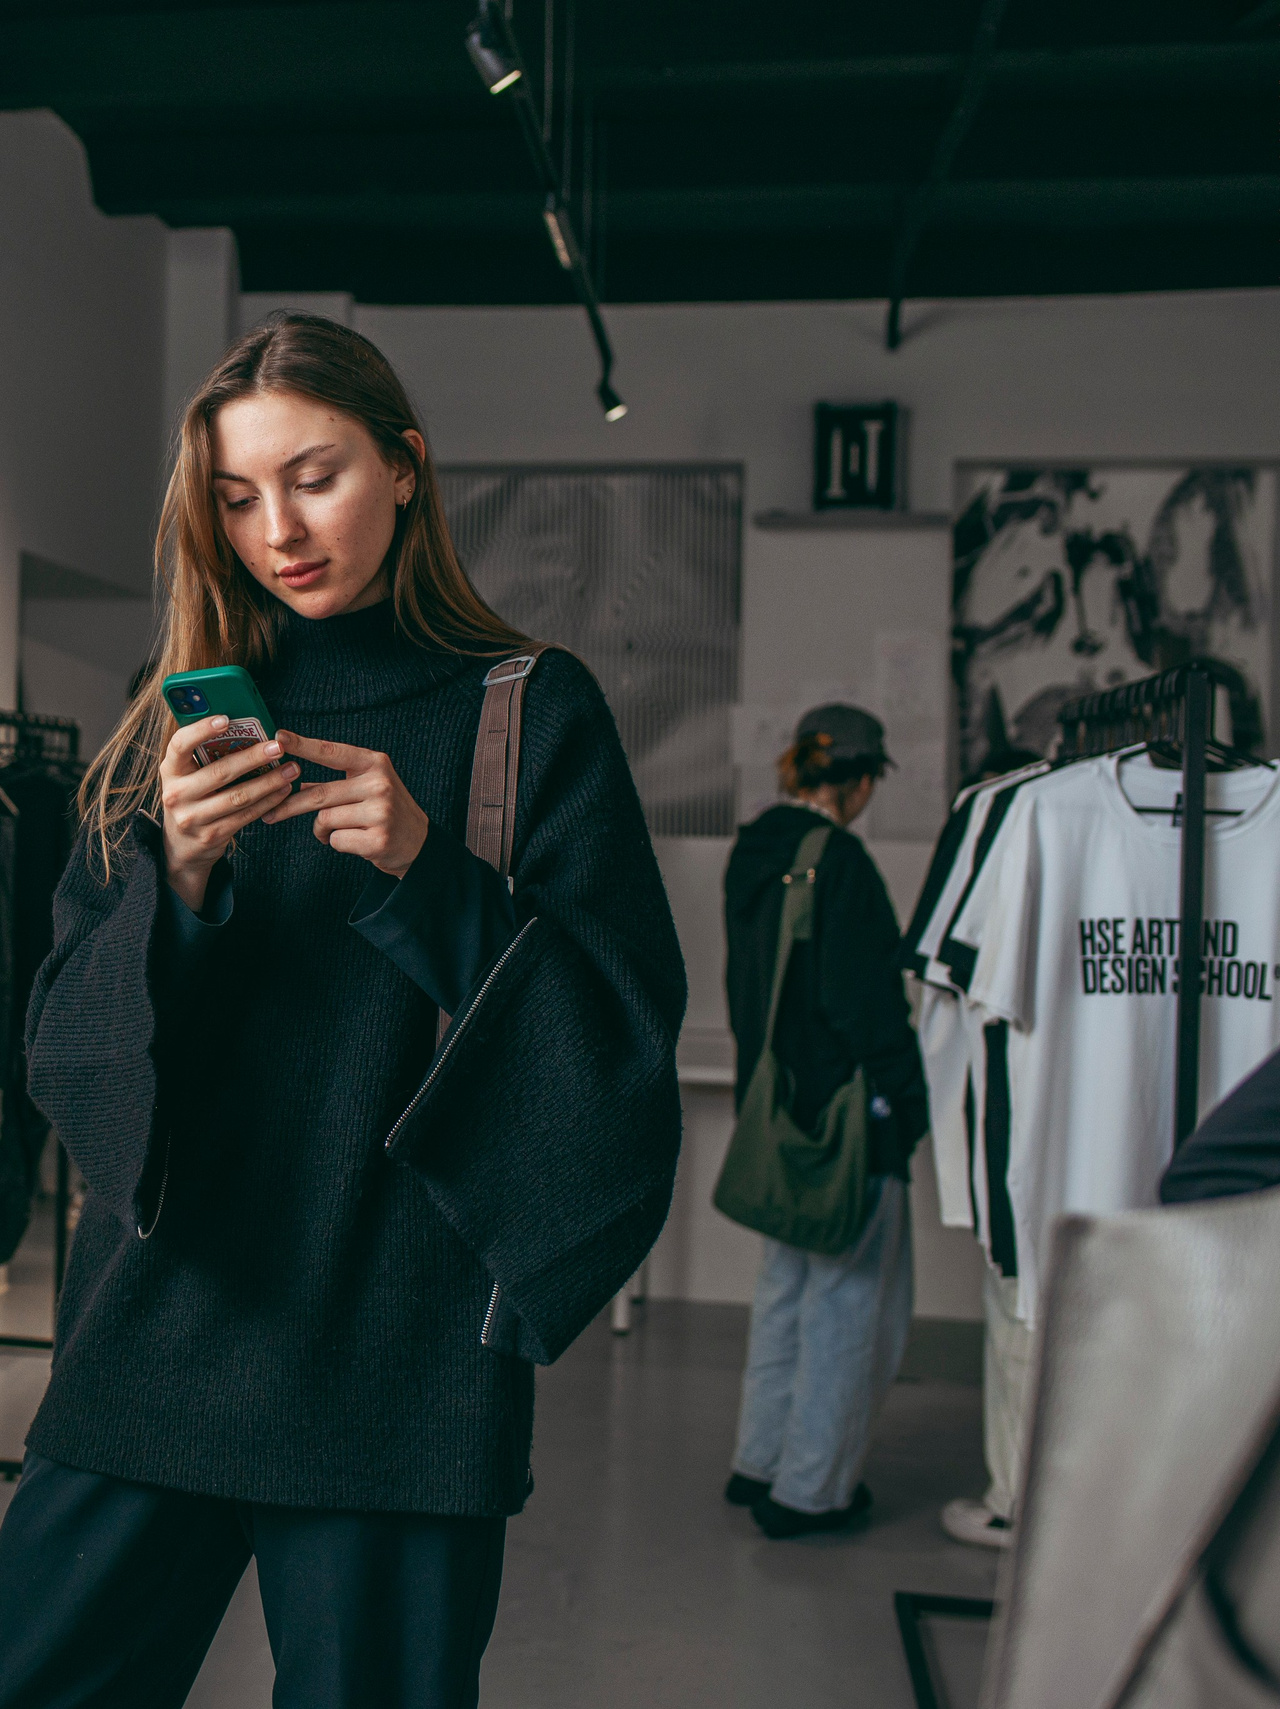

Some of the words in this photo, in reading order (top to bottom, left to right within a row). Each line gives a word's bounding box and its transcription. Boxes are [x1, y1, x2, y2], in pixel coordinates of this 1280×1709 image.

[1080, 917, 1126, 956] HSE
[1132, 917, 1180, 956] ART
[1202, 919, 1240, 957] ND
[1081, 956, 1167, 995] DESIGN
